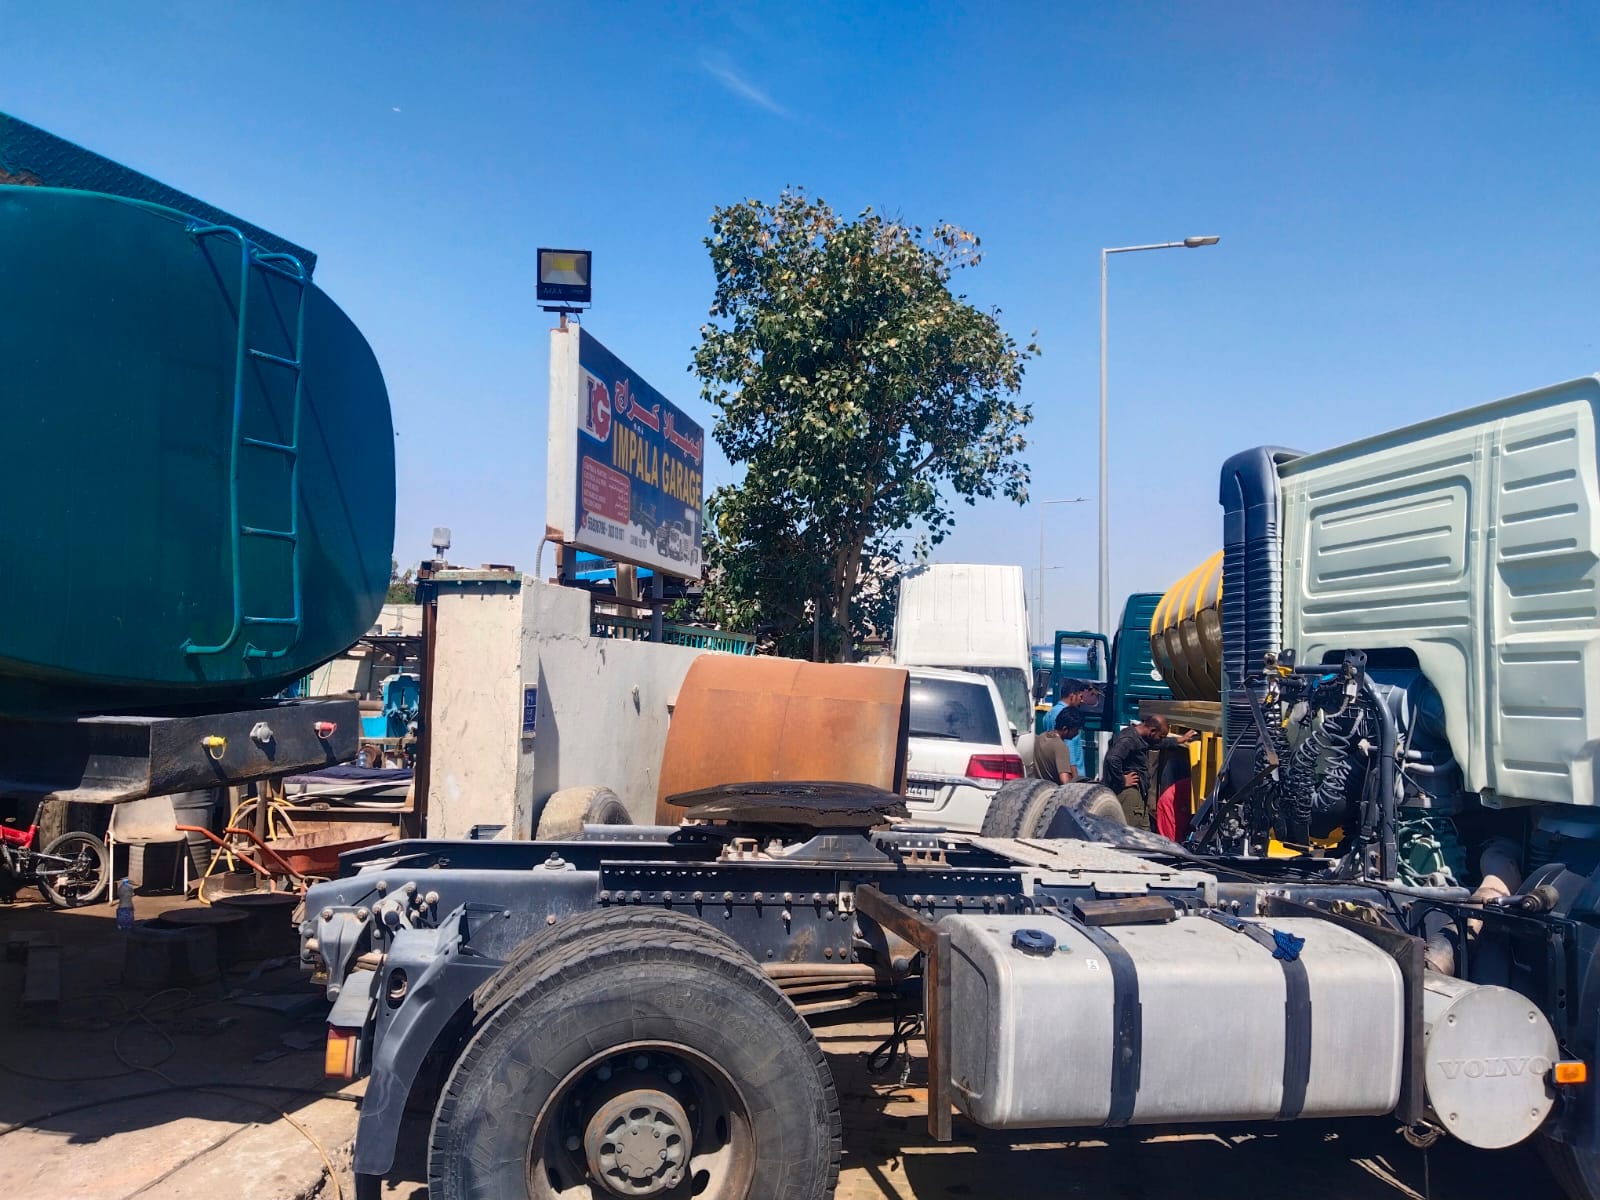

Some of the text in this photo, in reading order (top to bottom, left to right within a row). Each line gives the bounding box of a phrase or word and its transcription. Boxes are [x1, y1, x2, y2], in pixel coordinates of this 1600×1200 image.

[613, 420, 702, 512] IMPALA GARAGE
[1437, 1055, 1550, 1079] VOLVO
